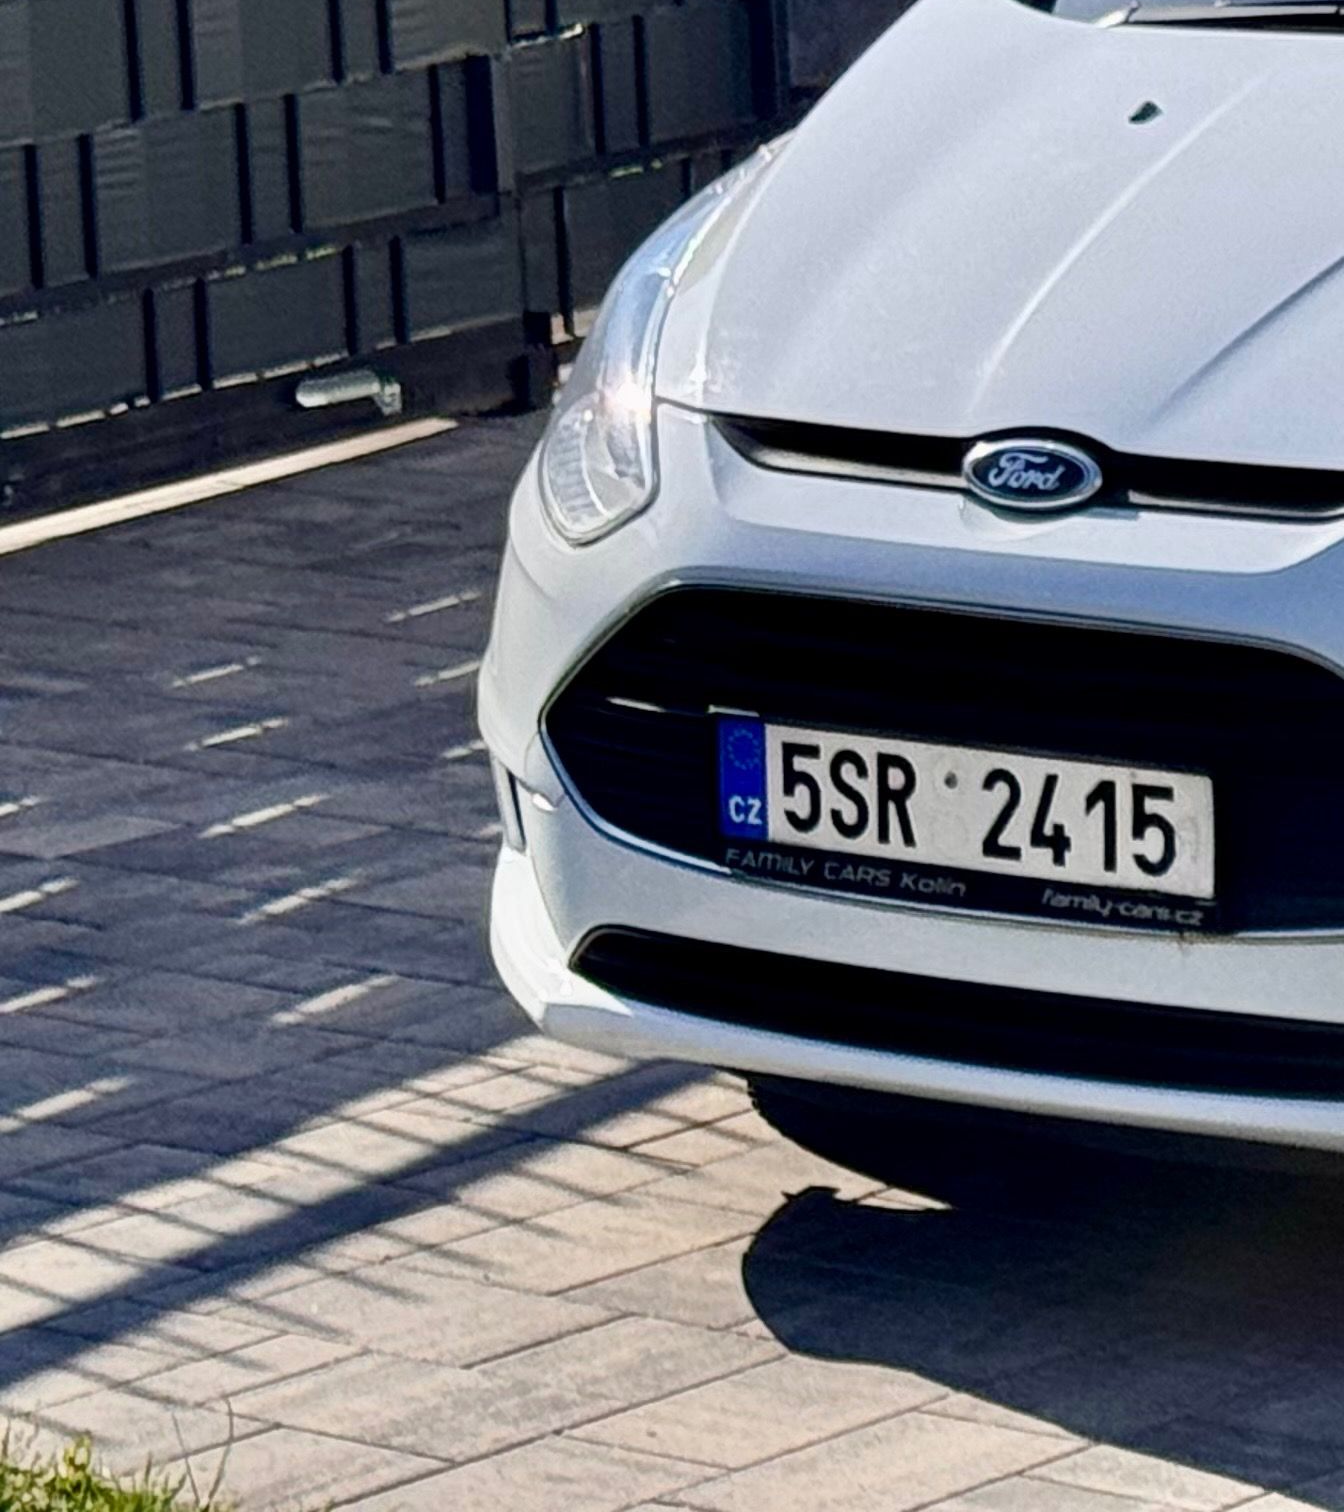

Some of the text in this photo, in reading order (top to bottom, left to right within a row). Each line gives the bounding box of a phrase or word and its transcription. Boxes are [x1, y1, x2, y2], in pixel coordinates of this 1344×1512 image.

[988, 452, 1067, 491] Ford
[728, 793, 763, 826] CZ
[780, 740, 1178, 878] 5SR 2415
[725, 847, 816, 876] FAMILY
[823, 861, 893, 887] CARS
